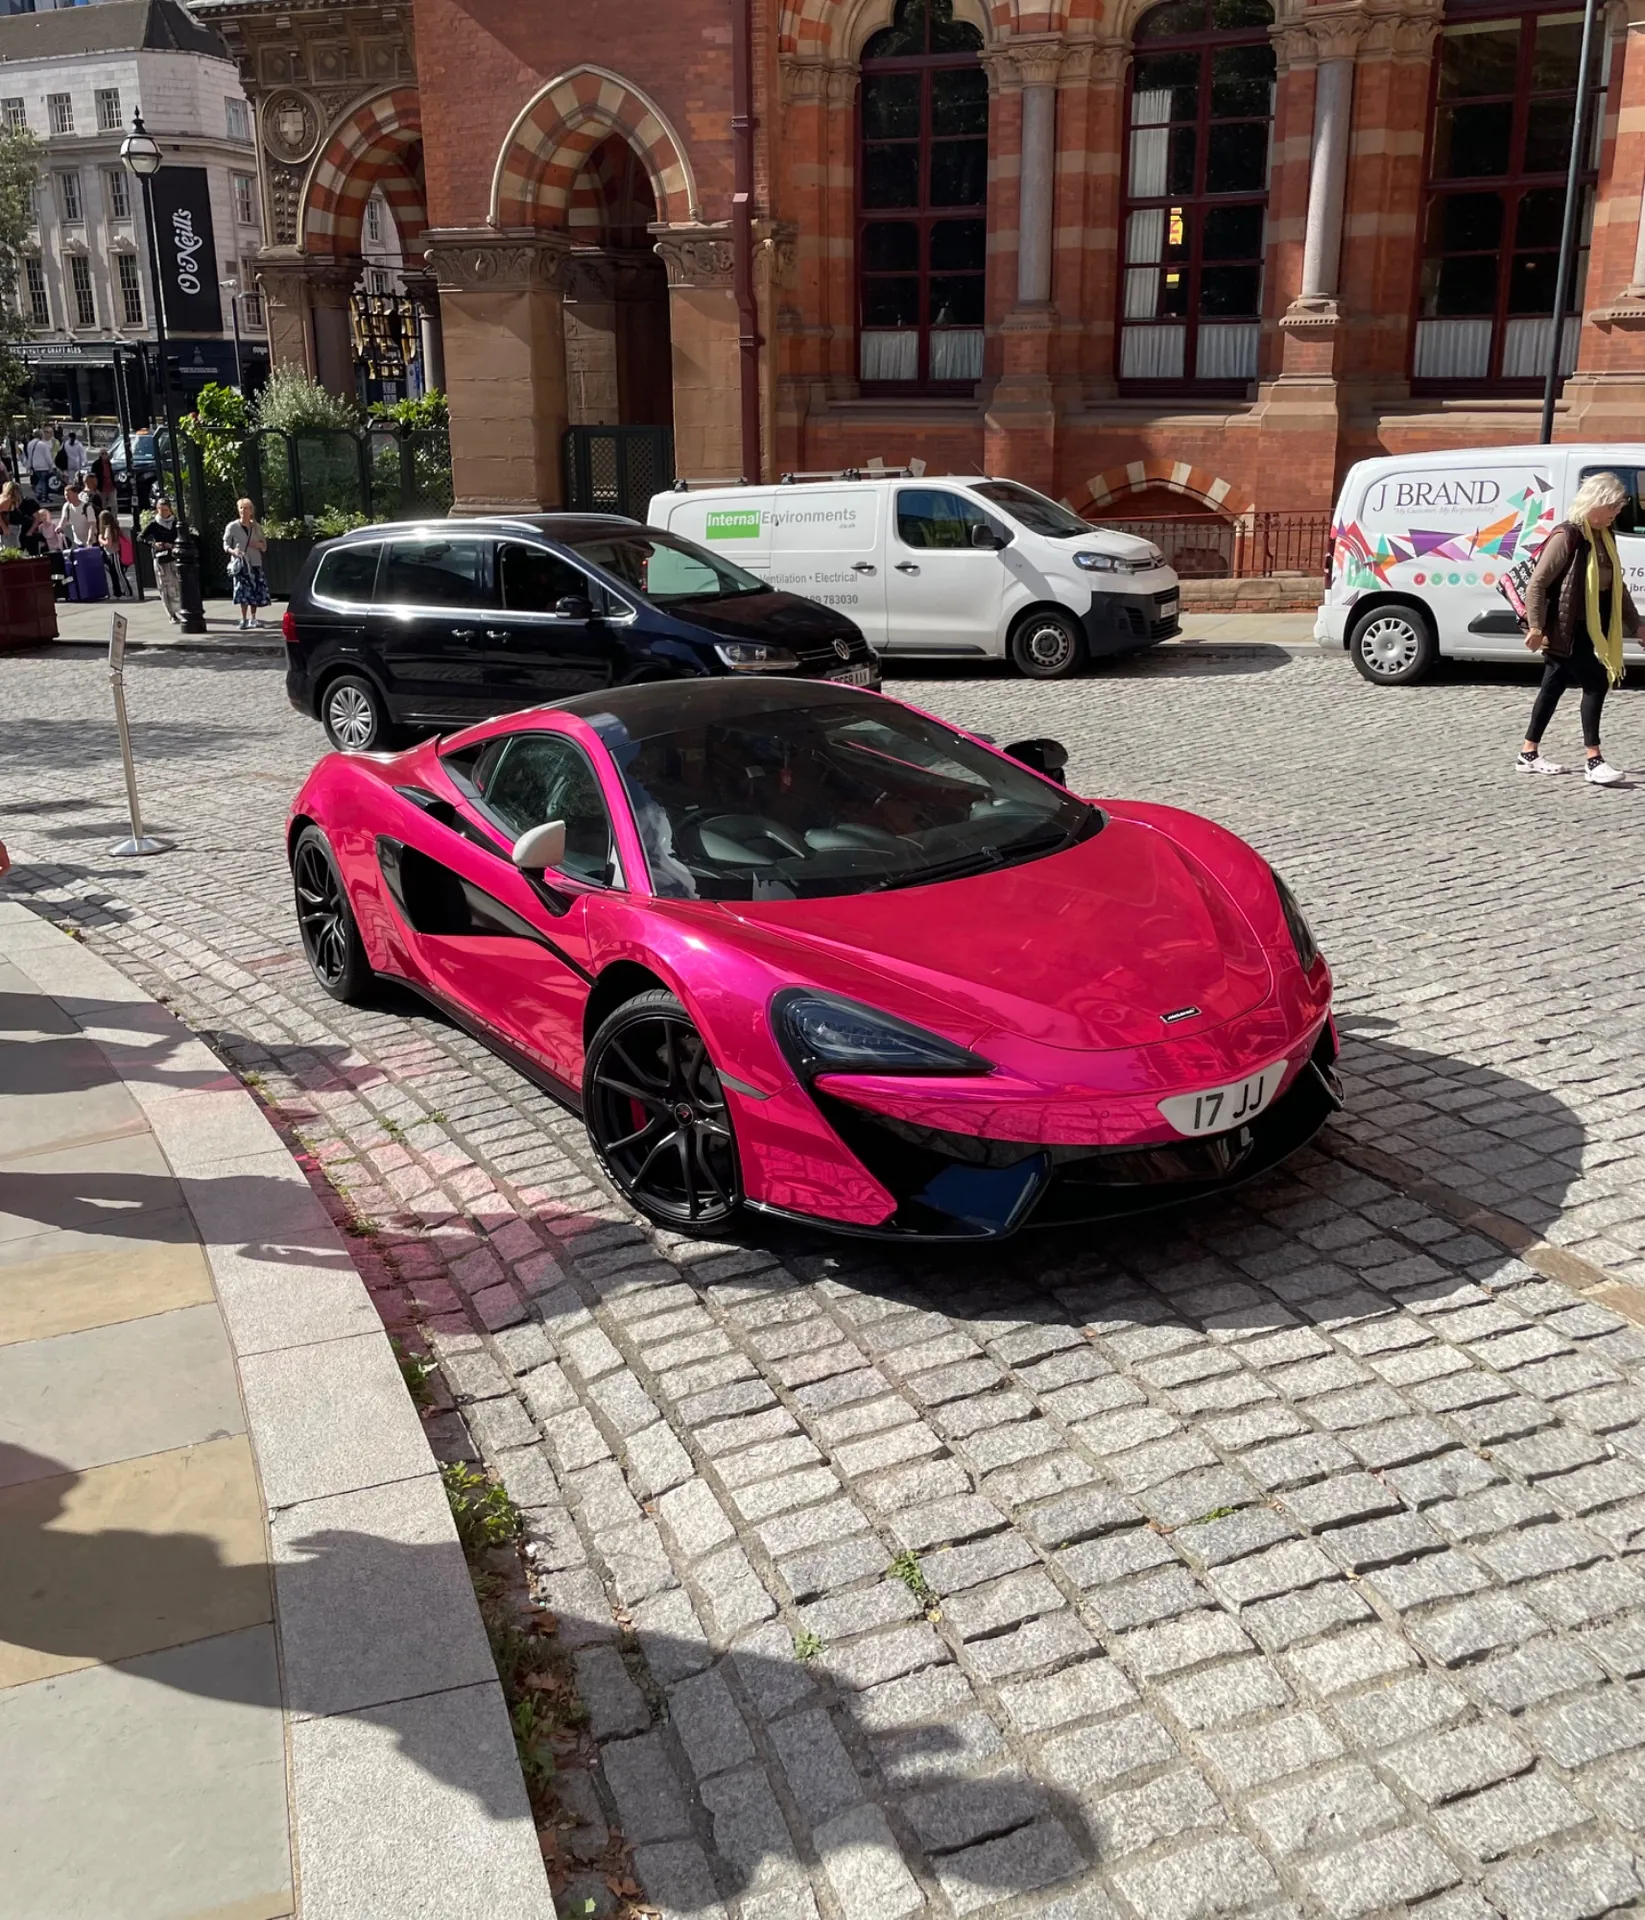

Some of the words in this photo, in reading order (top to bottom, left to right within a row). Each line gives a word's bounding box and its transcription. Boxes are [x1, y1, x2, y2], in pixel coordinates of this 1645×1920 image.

[172, 208, 203, 295] O'Neill's
[1373, 484, 1388, 512] J
[1395, 480, 1500, 507] BRAND
[707, 511, 759, 527] Internal
[761, 508, 856, 525] Environments
[814, 572, 858, 583] Electrical
[823, 594, 859, 605] 783030
[1194, 1092, 1224, 1130] 17
[1232, 1076, 1264, 1119] JJ
